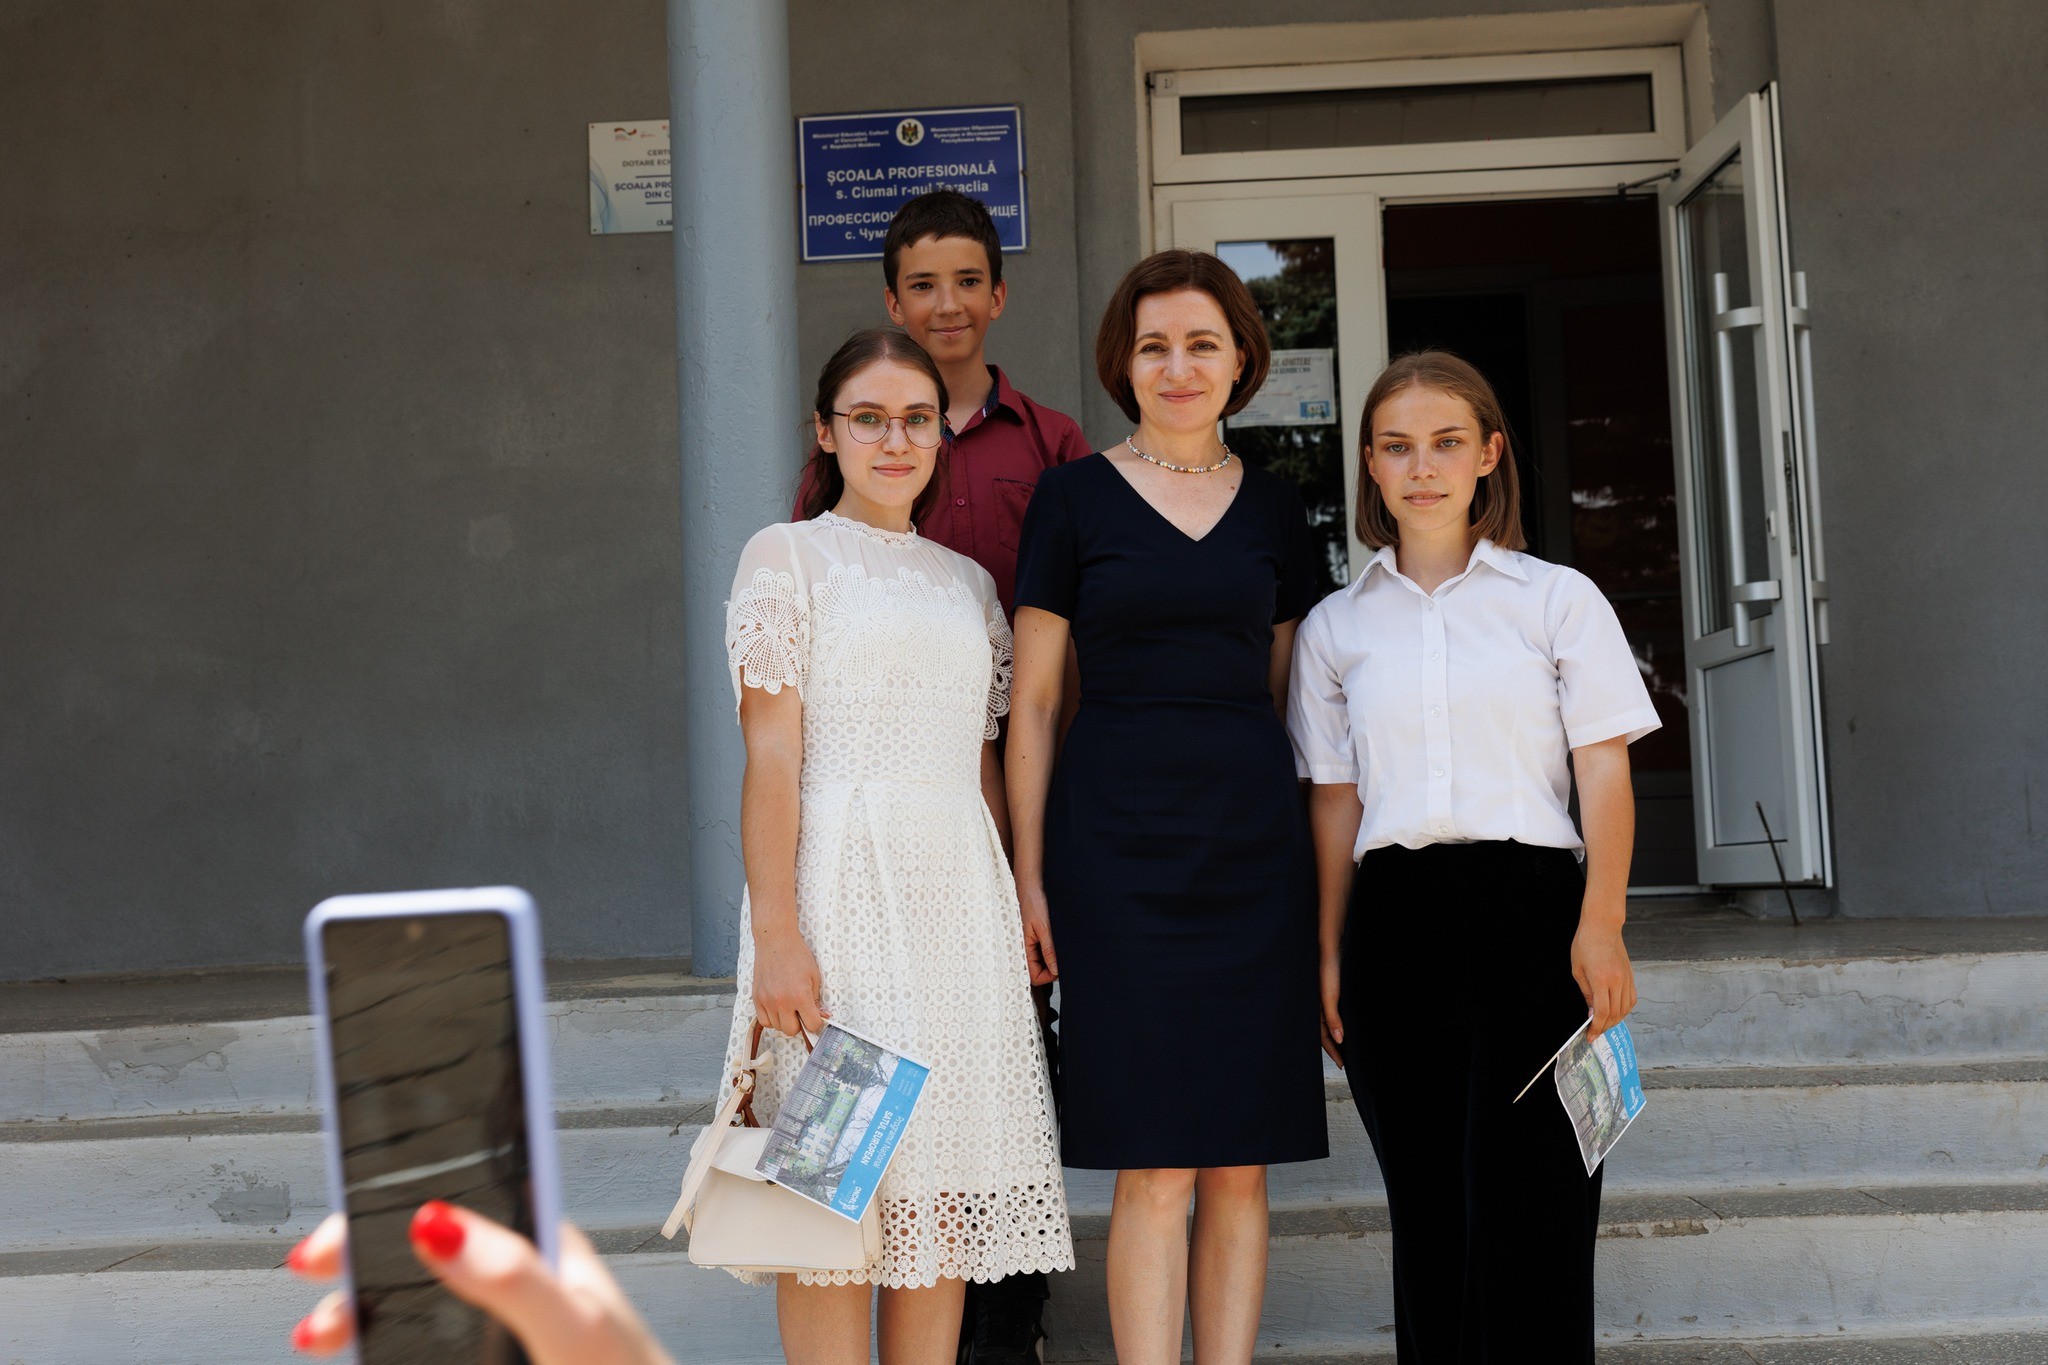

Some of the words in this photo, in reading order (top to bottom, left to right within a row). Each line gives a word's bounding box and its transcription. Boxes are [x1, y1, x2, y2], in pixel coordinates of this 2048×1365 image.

[622, 159, 655, 167] DOTARE
[826, 168, 885, 187] ȘCOALA
[888, 160, 997, 180] PROFESIONALĂ
[644, 190, 662, 199] DIN
[836, 189, 848, 200] s.
[851, 183, 898, 199] Ciumai
[901, 182, 933, 196] r-nul
[845, 231, 856, 241] с.
[877, 1110, 893, 1130] SATUL
[886, 1115, 905, 1145] Programul
[860, 1130, 883, 1166] EUROPEAN
